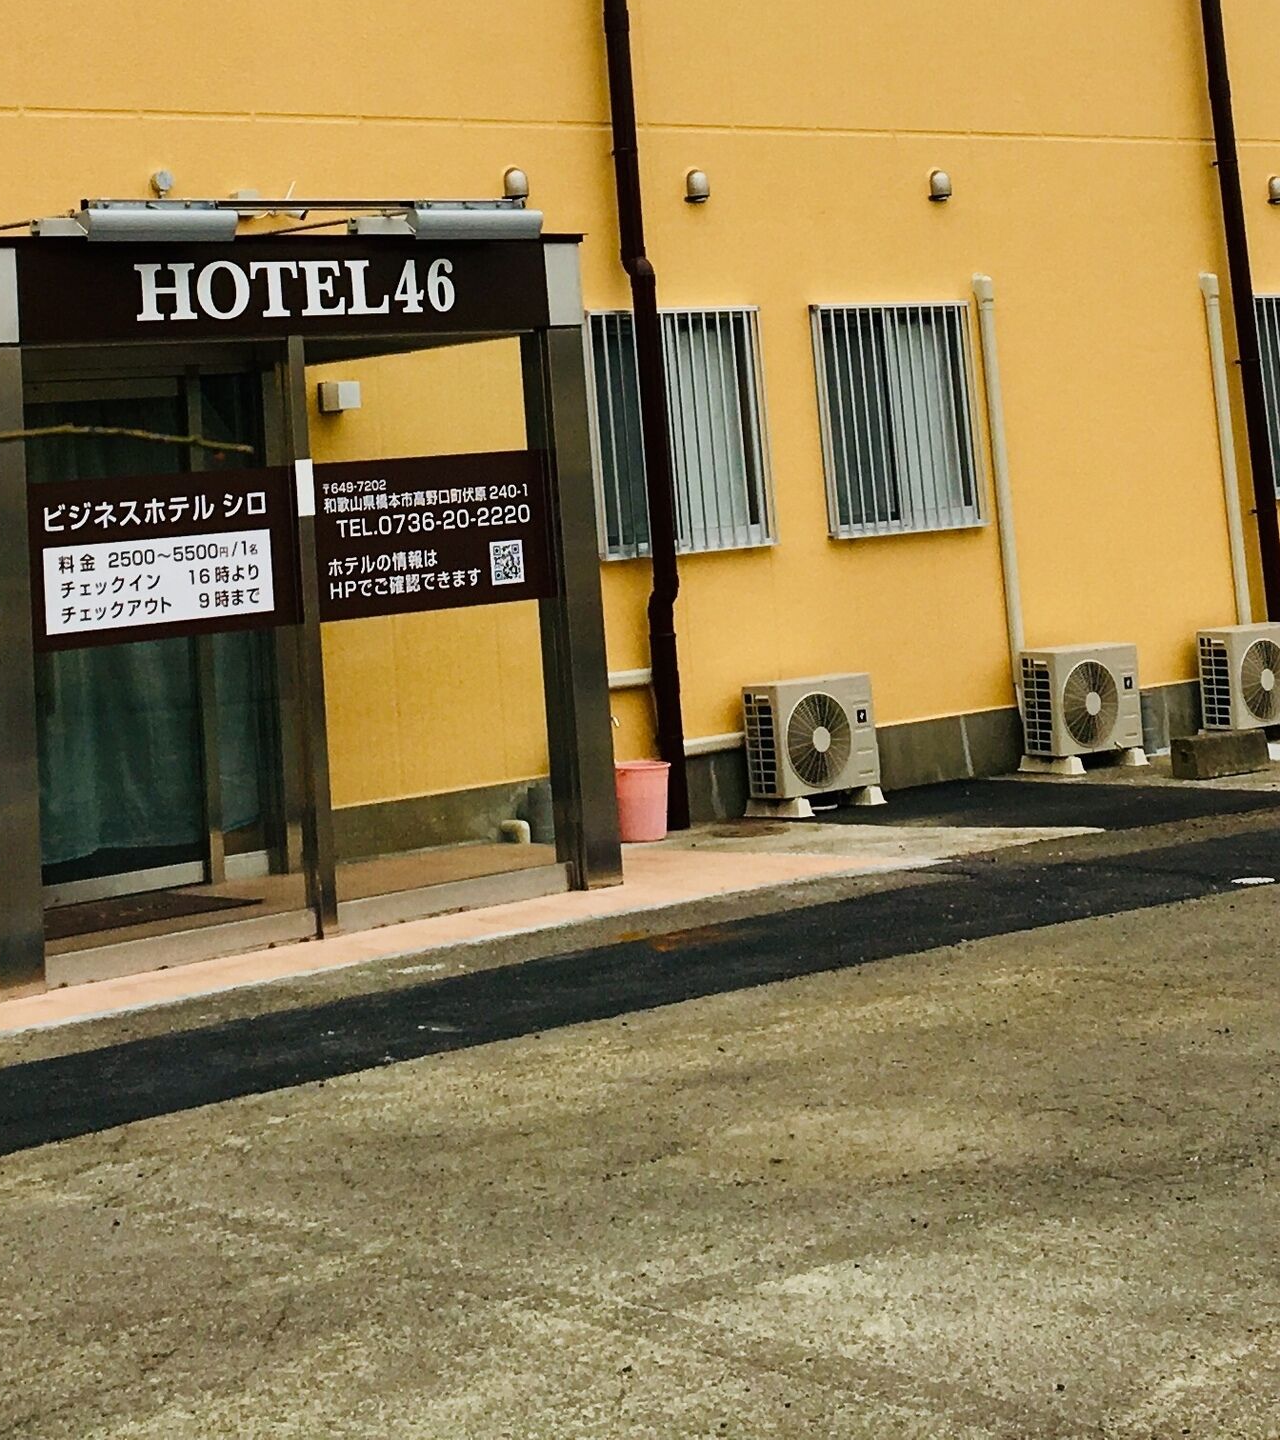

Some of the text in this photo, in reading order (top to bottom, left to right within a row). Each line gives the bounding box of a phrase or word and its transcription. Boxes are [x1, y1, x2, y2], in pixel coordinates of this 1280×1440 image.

[134, 258, 456, 322] HOTEL46
[43, 494, 215, 532] ビジネスホテル
[335, 504, 531, 538] TEL.0736-20-2220
[328, 549, 438, 577] ホテルの情報は
[60, 573, 161, 599] チェックイン
[329, 567, 482, 600] HPでご確認できます
[61, 596, 172, 624] チェックアウト
